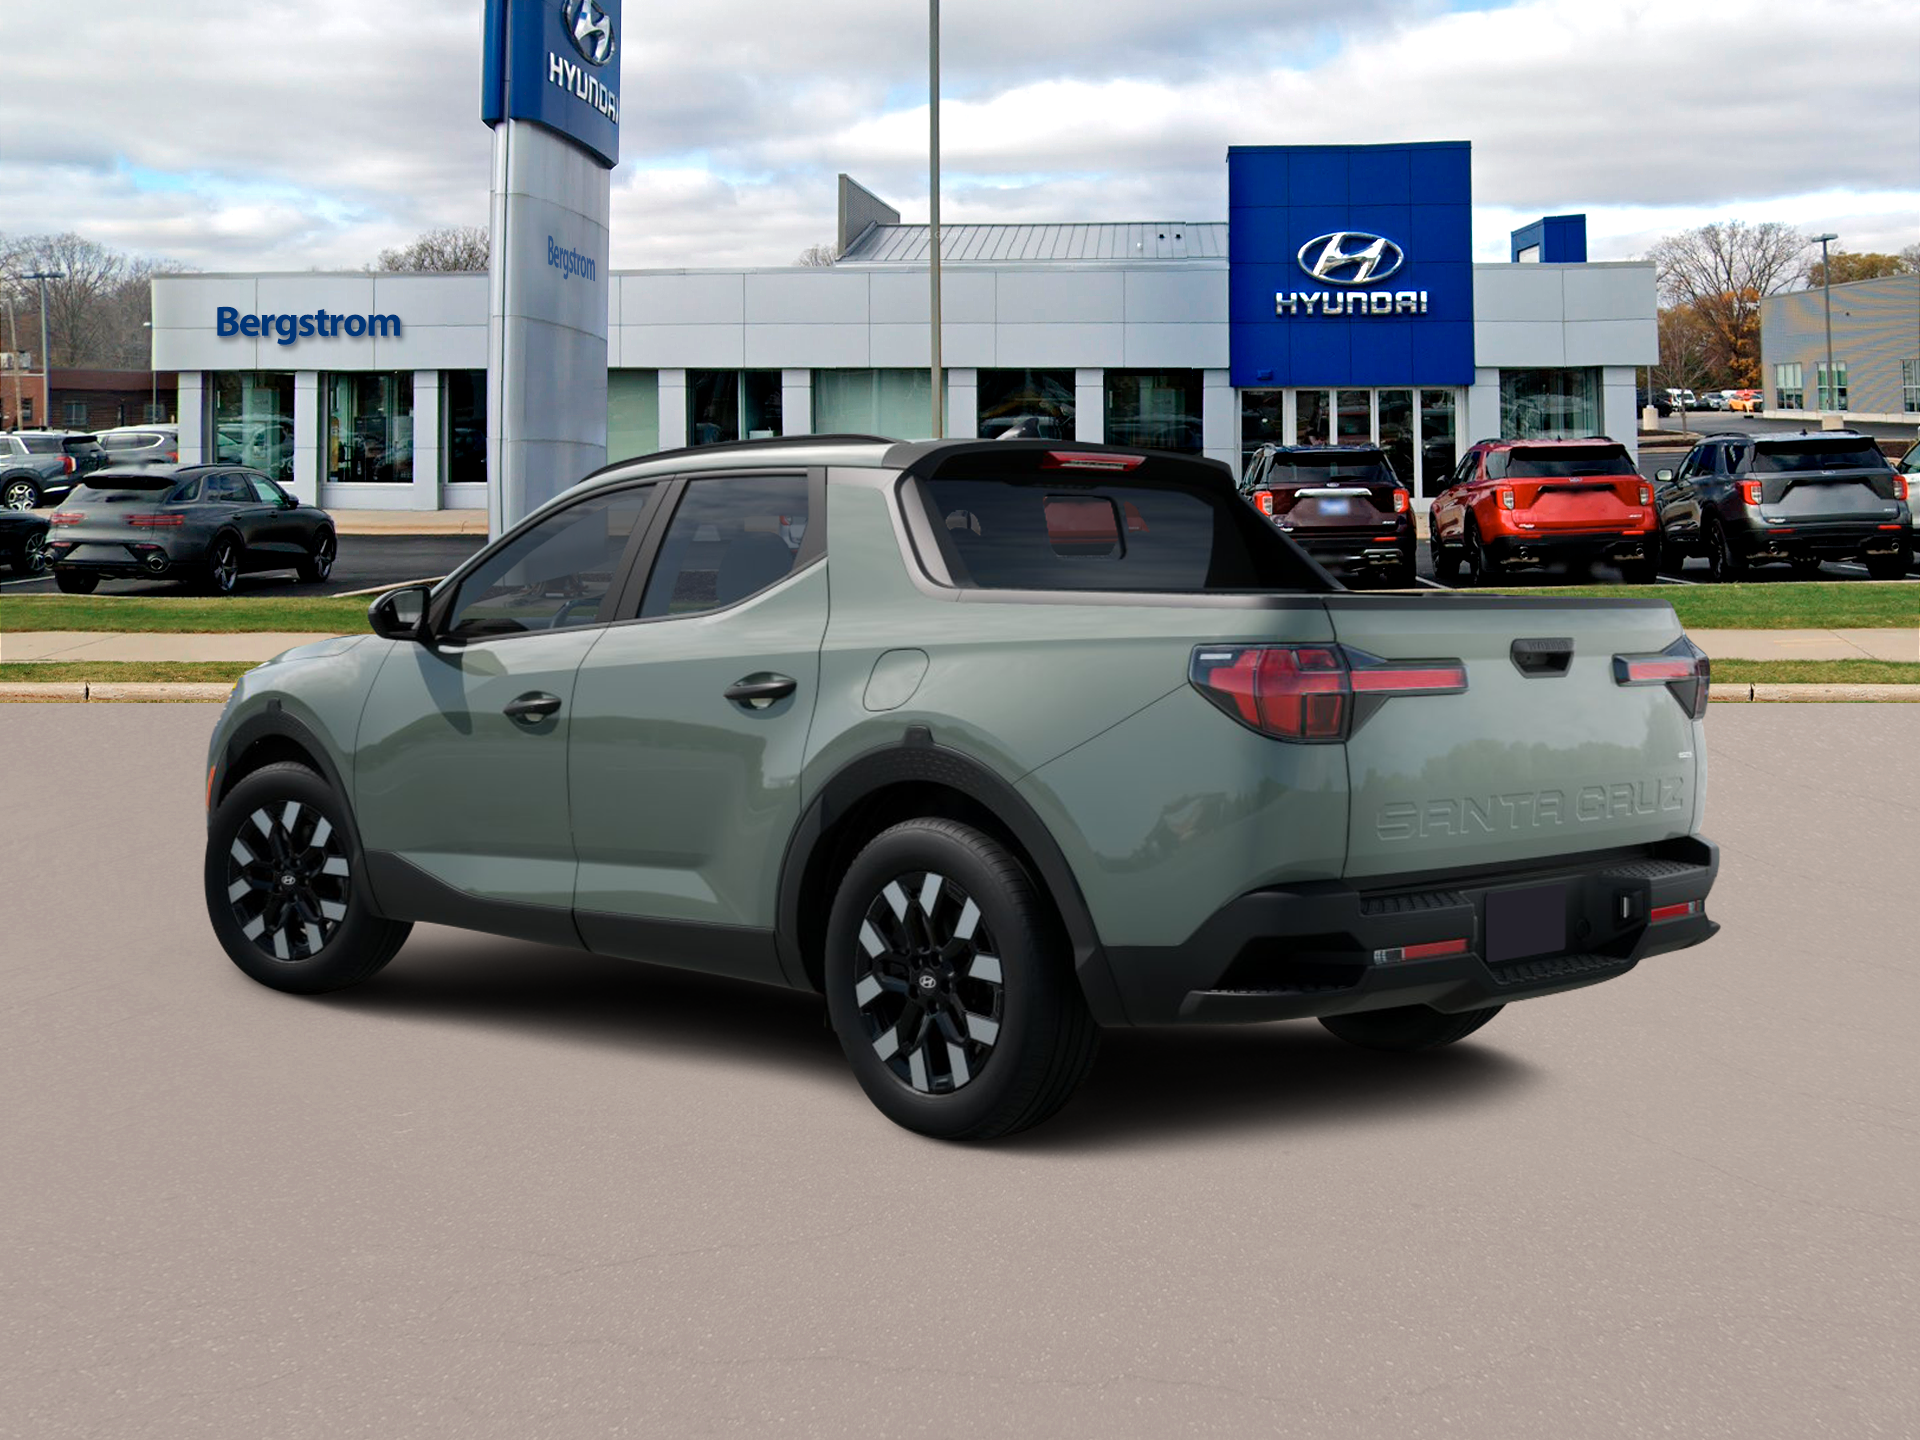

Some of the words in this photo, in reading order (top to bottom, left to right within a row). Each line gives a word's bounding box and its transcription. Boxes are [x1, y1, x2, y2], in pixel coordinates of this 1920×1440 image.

[548, 52, 619, 124] HYUNDAI
[547, 235, 596, 282] Bergstrom
[216, 306, 401, 346] Bergstrom
[1275, 291, 1428, 315] HYUNDAI
[1376, 789, 1566, 841] SANTA
[1576, 777, 1684, 822] CRUZ
